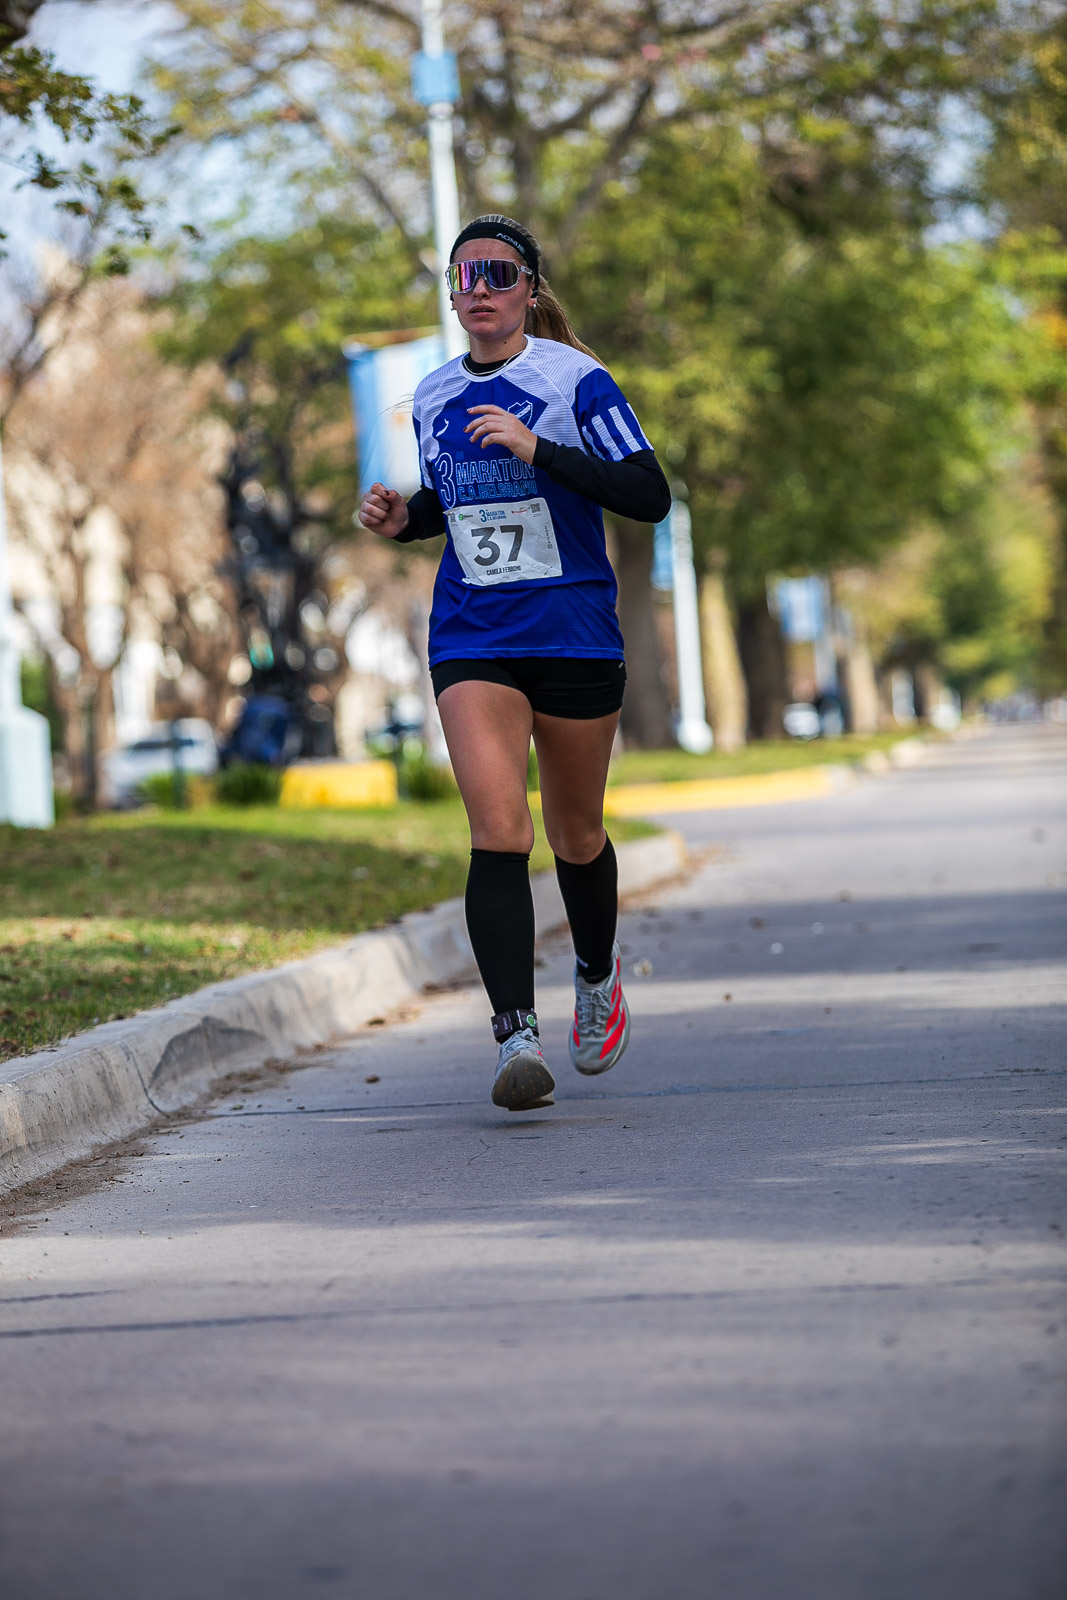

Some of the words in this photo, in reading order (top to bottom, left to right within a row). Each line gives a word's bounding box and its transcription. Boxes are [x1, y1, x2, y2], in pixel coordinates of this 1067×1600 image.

[435, 452, 456, 509] 3
[455, 453, 535, 485] MARATÓN
[479, 509, 488, 522] 3
[470, 524, 524, 566] 37
